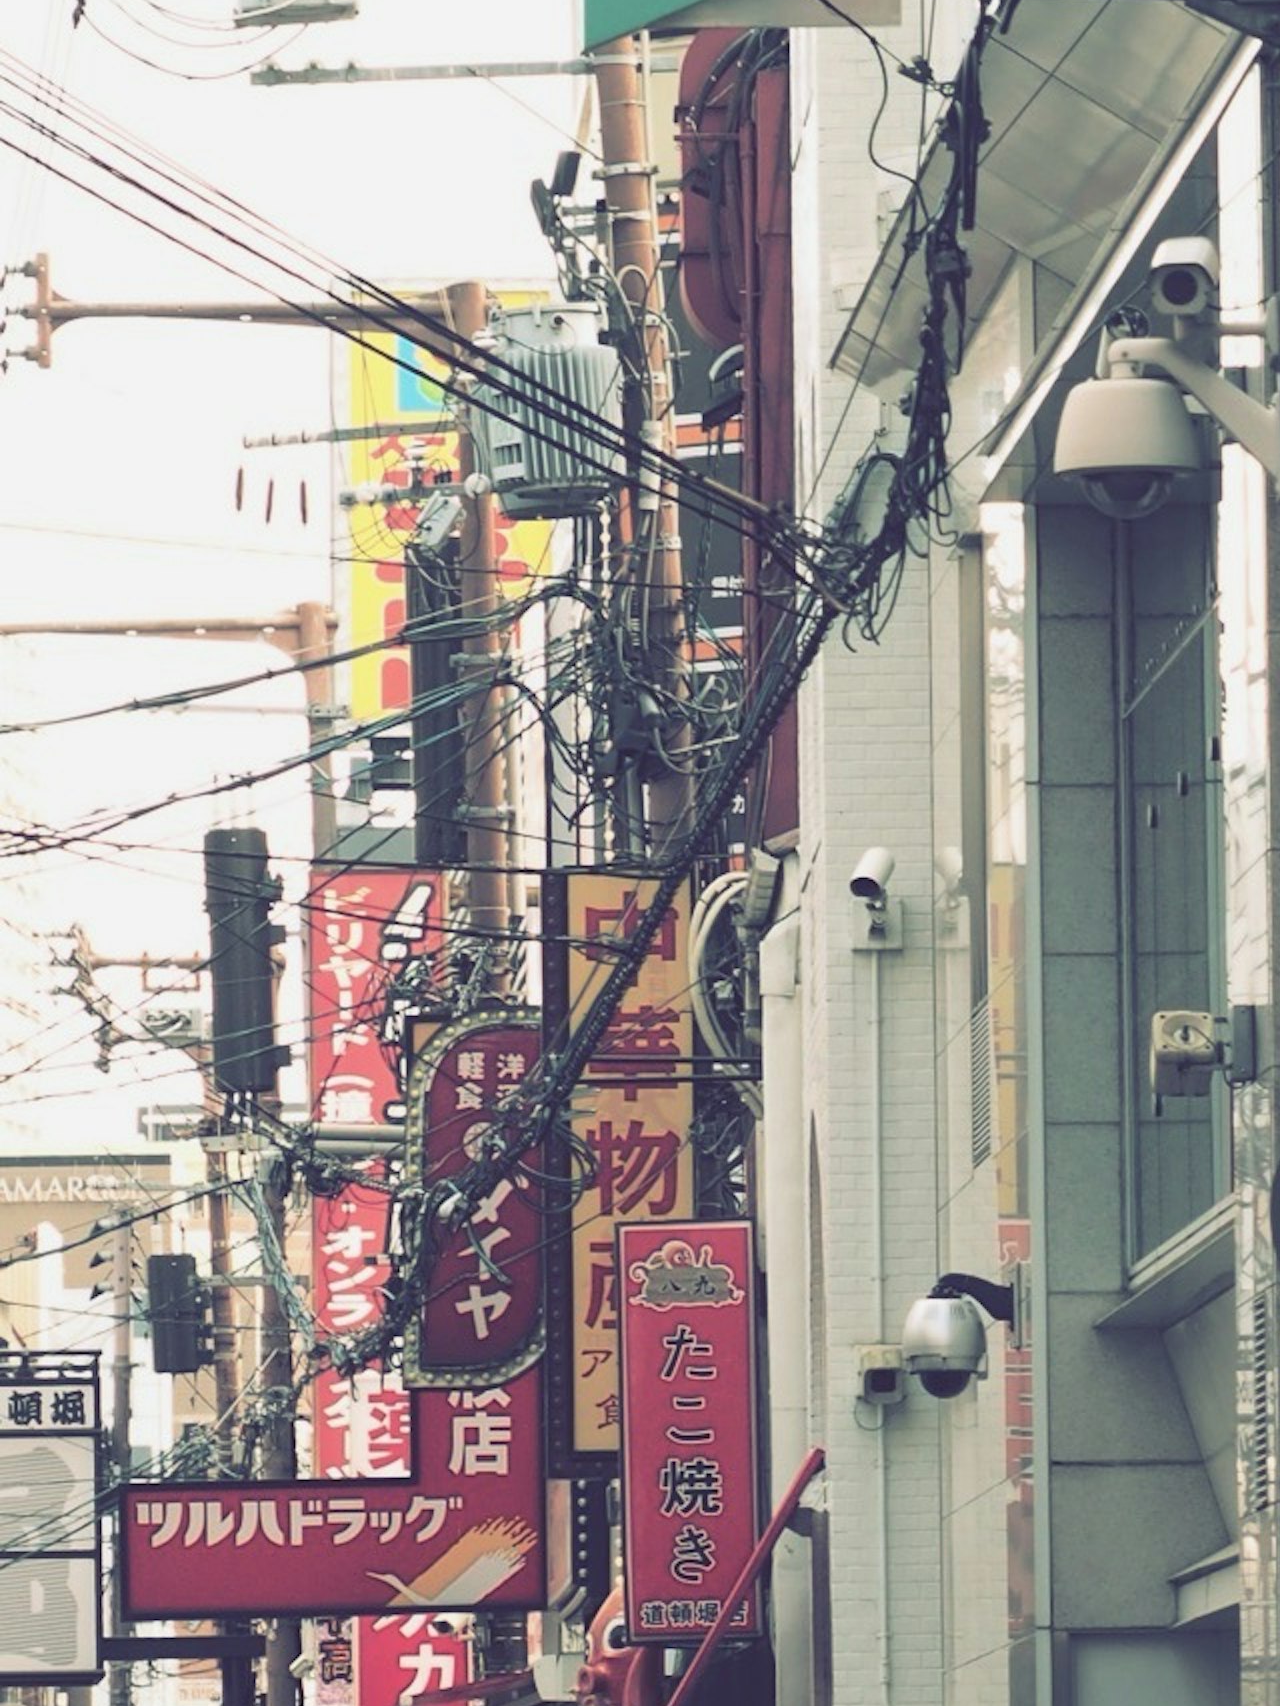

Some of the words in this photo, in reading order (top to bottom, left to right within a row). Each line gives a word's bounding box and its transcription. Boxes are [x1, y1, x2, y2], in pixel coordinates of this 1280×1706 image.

[135, 1495, 463, 1548] ツルハドラッグ
[660, 1325, 723, 1583] たこ焼き
